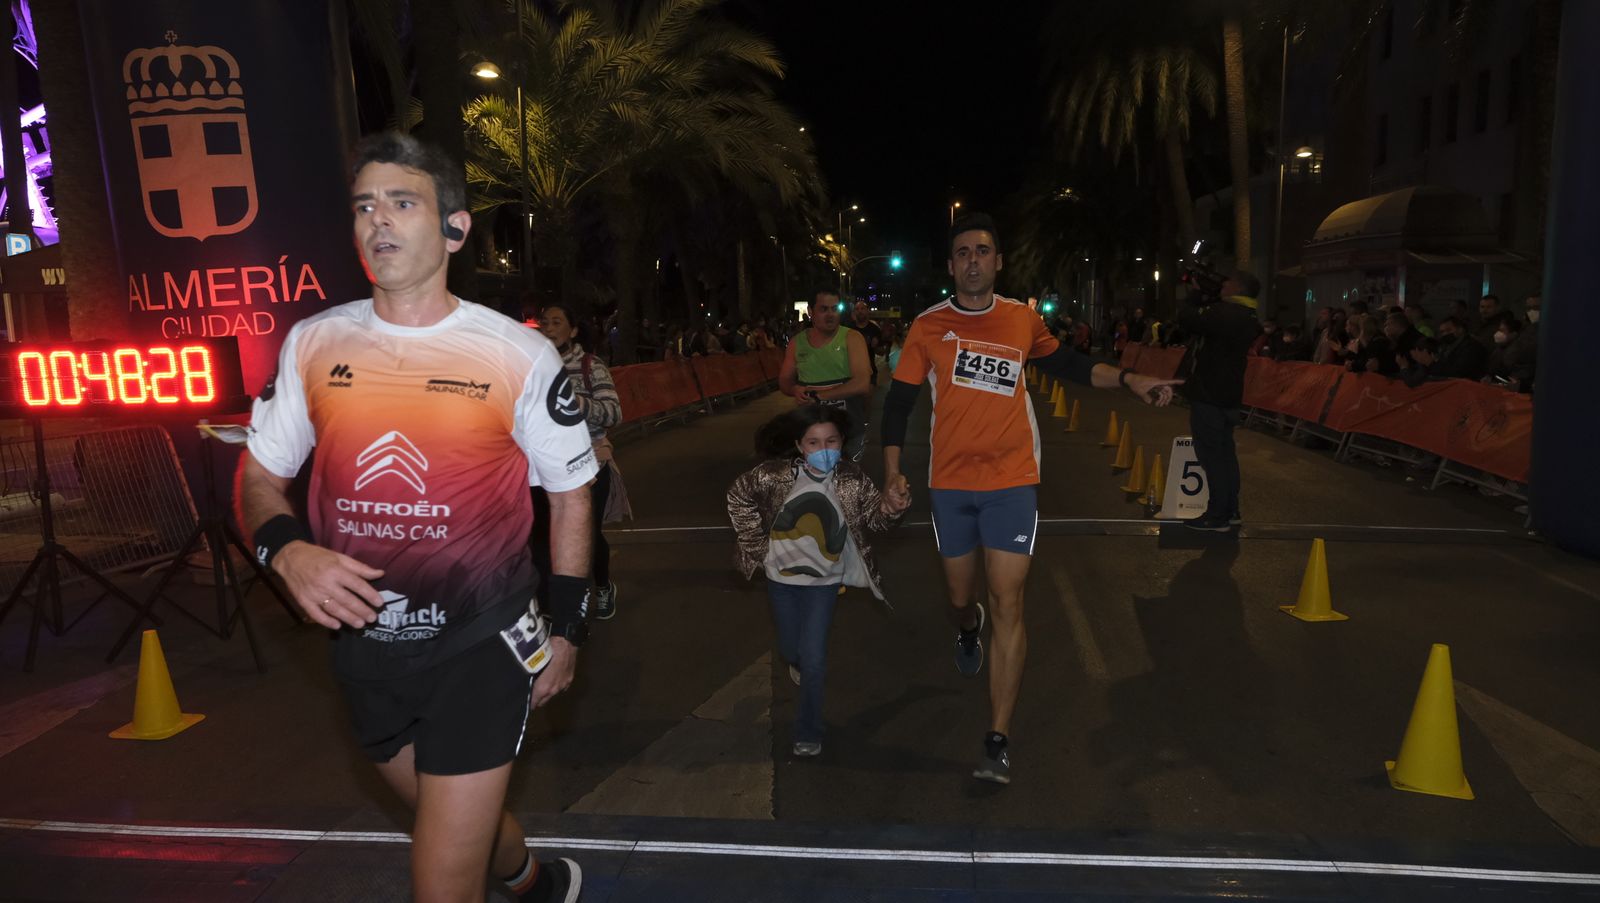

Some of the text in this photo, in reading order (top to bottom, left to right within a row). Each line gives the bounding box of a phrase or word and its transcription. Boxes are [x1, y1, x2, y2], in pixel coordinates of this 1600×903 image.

[11, 237, 27, 256] P
[128, 254, 327, 312] ALMERÍA
[161, 311, 276, 339] CIUDAD
[18, 346, 215, 406] 00:48:28
[968, 355, 1011, 378] 456
[425, 384, 488, 401] SALINAS CAR
[1181, 461, 1204, 496] 5
[338, 519, 448, 540] SALINAS CAR
